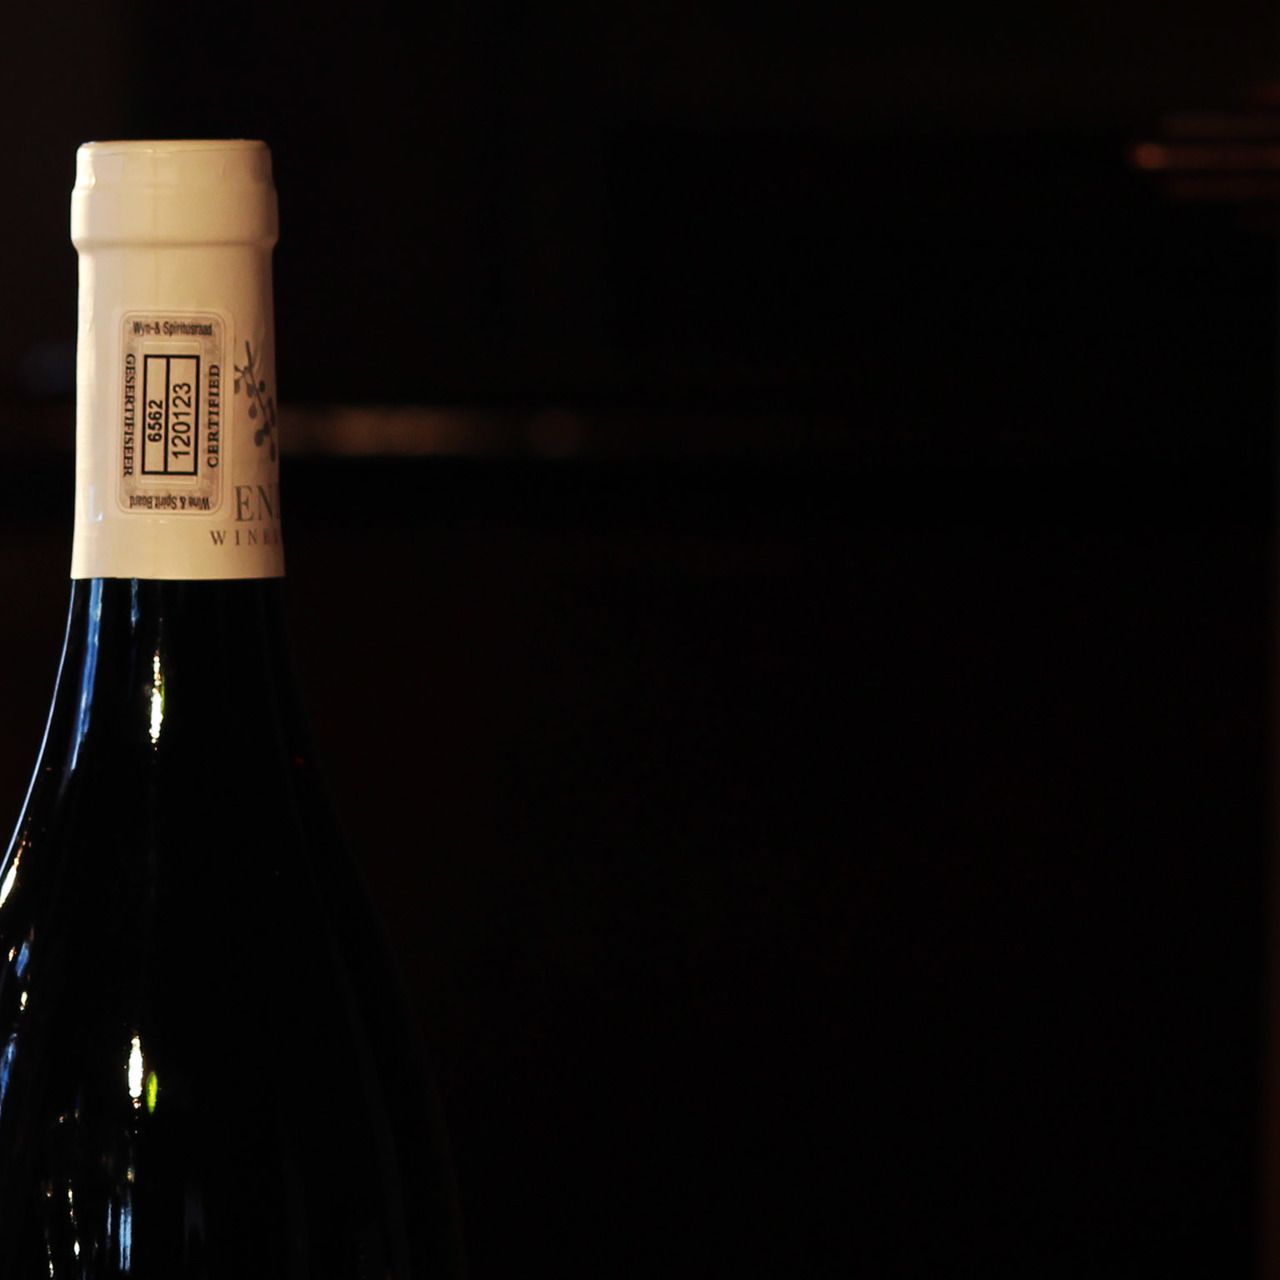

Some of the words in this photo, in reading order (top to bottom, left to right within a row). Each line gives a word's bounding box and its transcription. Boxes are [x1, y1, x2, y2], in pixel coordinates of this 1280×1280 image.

[147, 399, 163, 443] 6562
[172, 382, 192, 459] 120123
[207, 364, 221, 468] CERTIFIED
